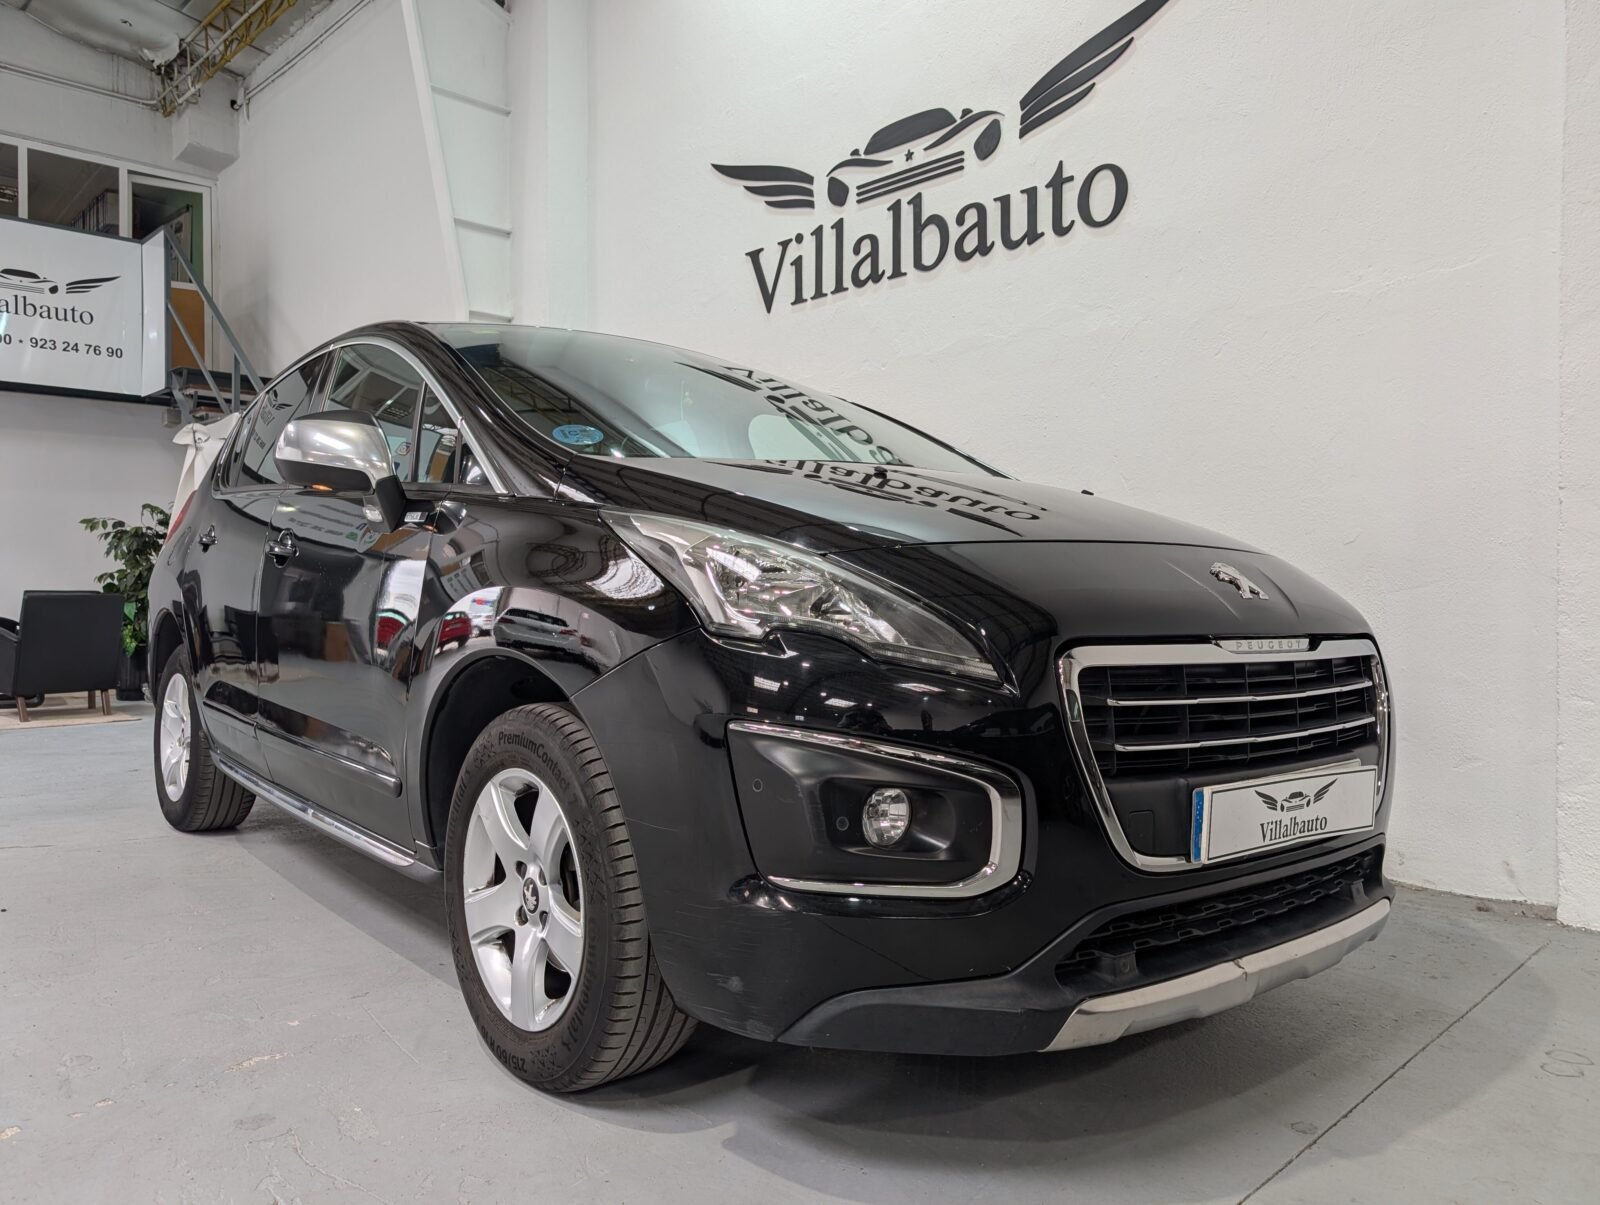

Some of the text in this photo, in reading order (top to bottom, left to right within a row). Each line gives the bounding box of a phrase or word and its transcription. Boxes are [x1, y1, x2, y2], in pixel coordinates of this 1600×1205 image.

[745, 160, 1129, 314] Villalbauto
[29, 337, 57, 351] 923
[61, 341, 80, 354] 24
[84, 343, 102, 356] 76
[106, 346, 123, 359] 90
[1235, 640, 1302, 650] PEUGEOT
[498, 731, 570, 792] PremiumContact
[1259, 815, 1328, 843] Villalbauto
[496, 1044, 528, 1074] 215/60
